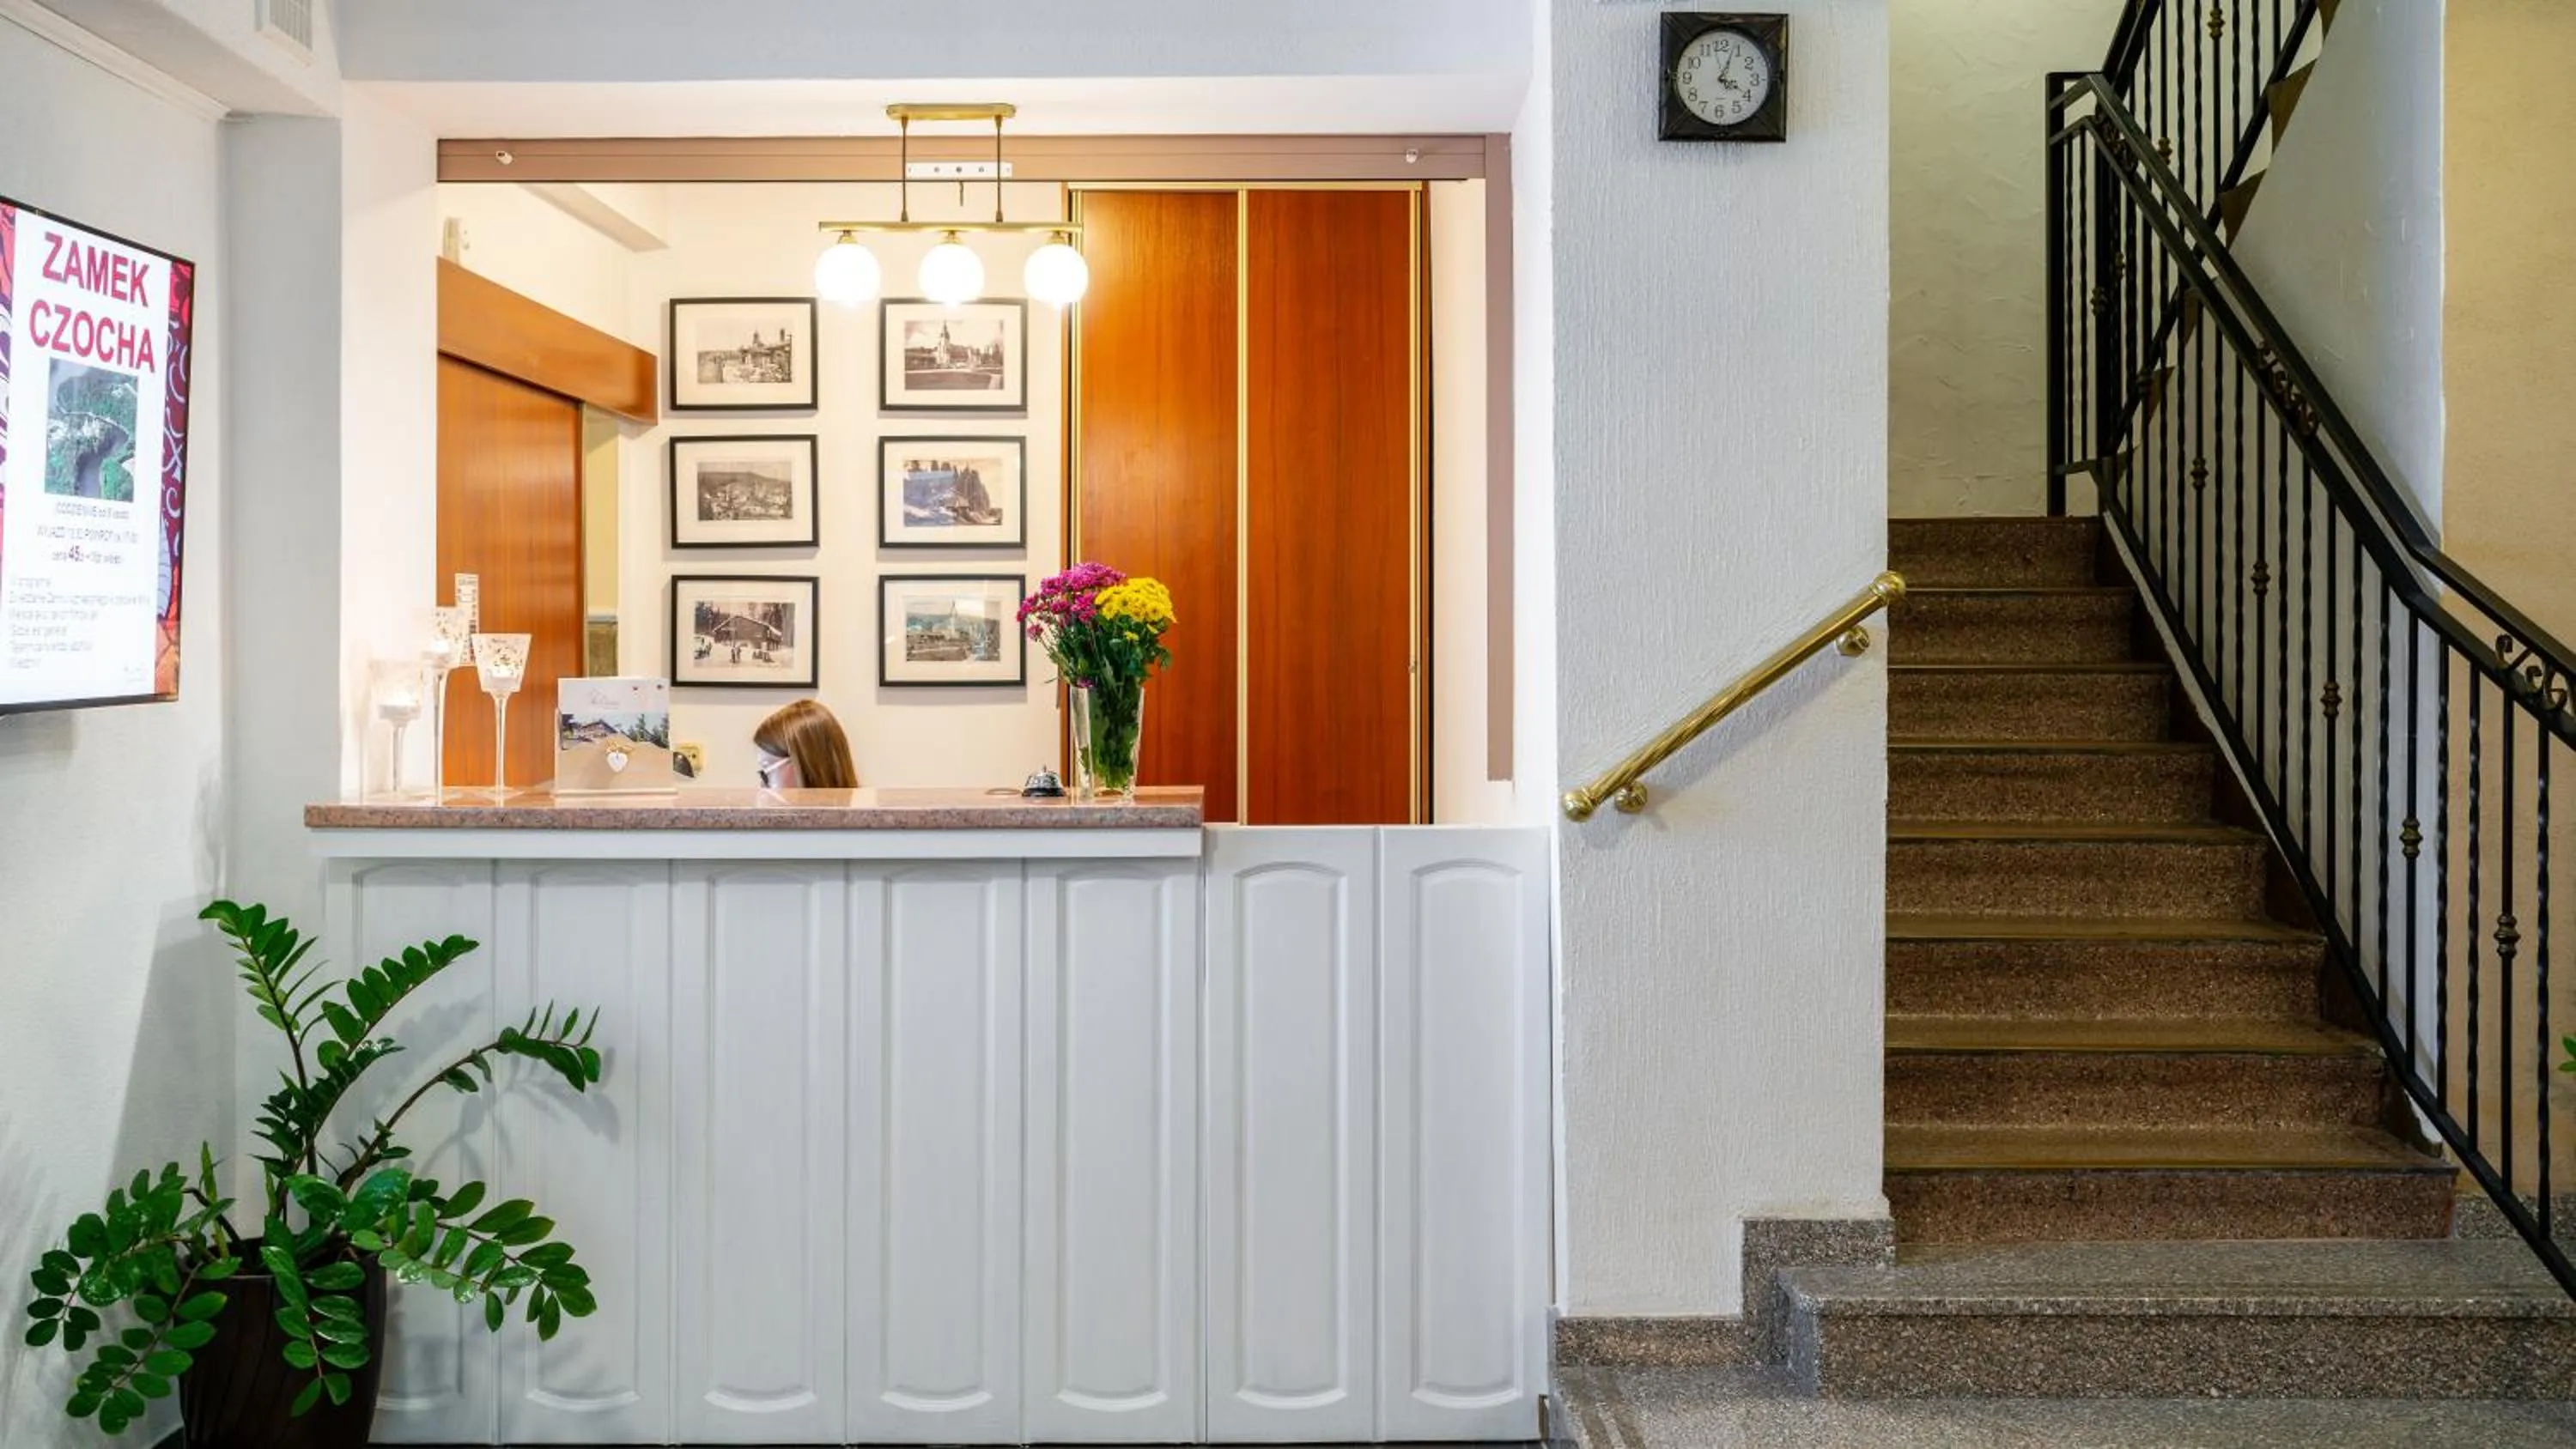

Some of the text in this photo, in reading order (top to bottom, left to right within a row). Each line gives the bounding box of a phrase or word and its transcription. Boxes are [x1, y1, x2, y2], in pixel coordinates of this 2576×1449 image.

[1700, 44, 1710, 57] 11
[1712, 39, 1729, 52] 12
[1735, 44, 1741, 58] 1
[1688, 56, 1701, 70] 10
[1744, 56, 1754, 70] 2
[1682, 71, 1692, 85] 9
[1750, 73, 1759, 87] 3
[1687, 87, 1698, 102] 8
[1741, 88, 1753, 102] 4
[1698, 100, 1710, 114] 7
[1714, 104, 1725, 119] 6
[1731, 100, 1742, 114] 5
[42, 231, 149, 307] ZAMEK
[29, 299, 155, 373] CZOCHA
